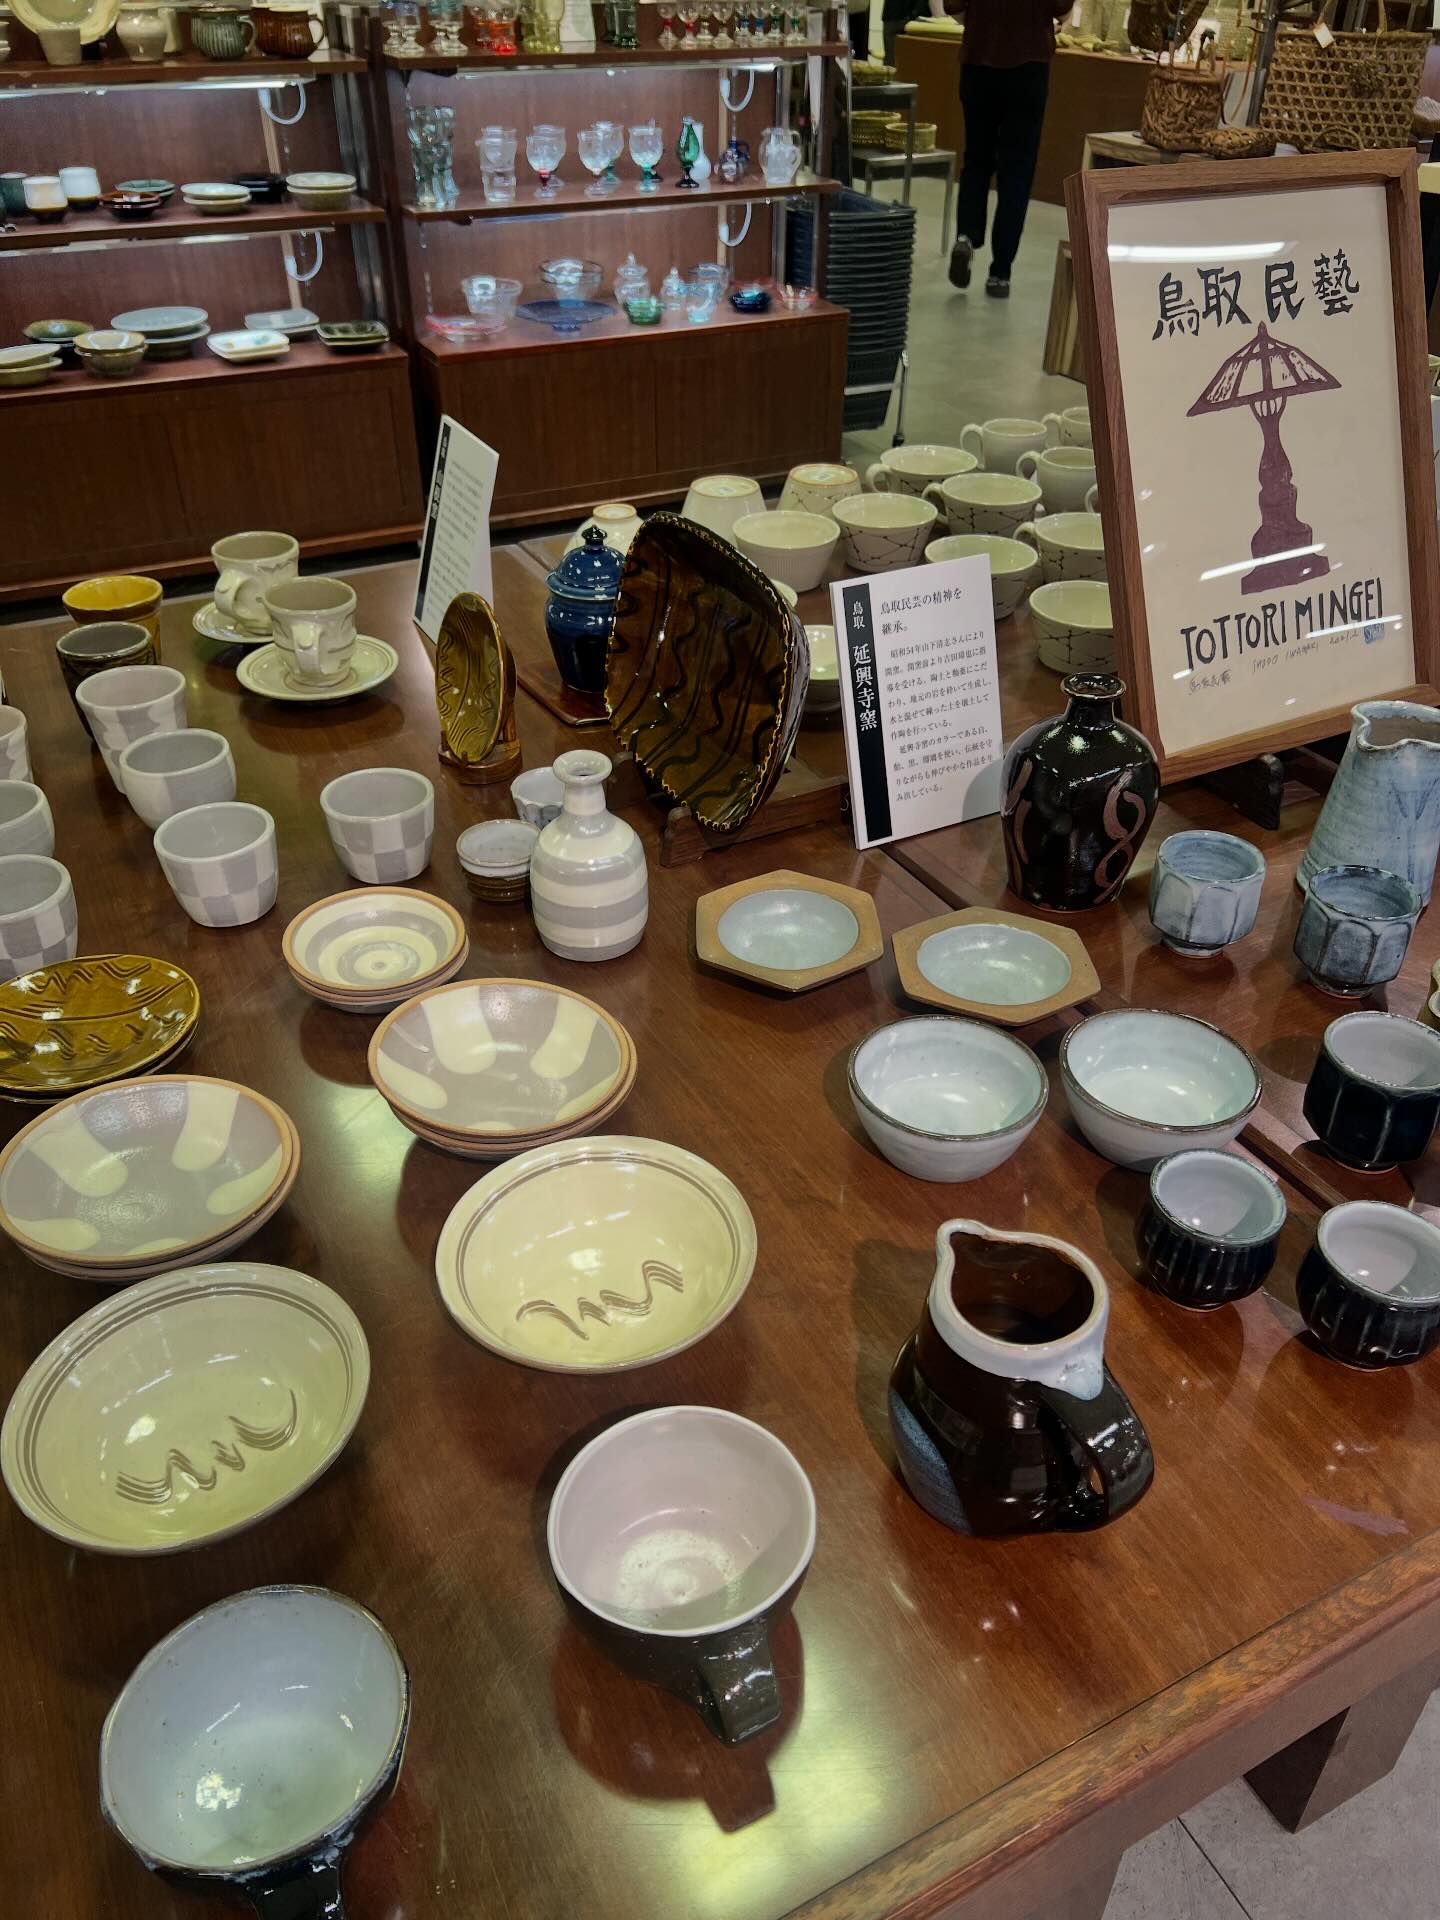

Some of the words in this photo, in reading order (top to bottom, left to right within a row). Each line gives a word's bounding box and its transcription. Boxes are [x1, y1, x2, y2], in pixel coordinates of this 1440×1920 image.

[852, 600, 866, 630] 鳥取
[880, 587, 962, 615] 鳥取民芸の精神を
[881, 620, 908, 636] 継承。
[1181, 601, 1287, 671] TOTTORI
[1295, 577, 1383, 640] MINGEI
